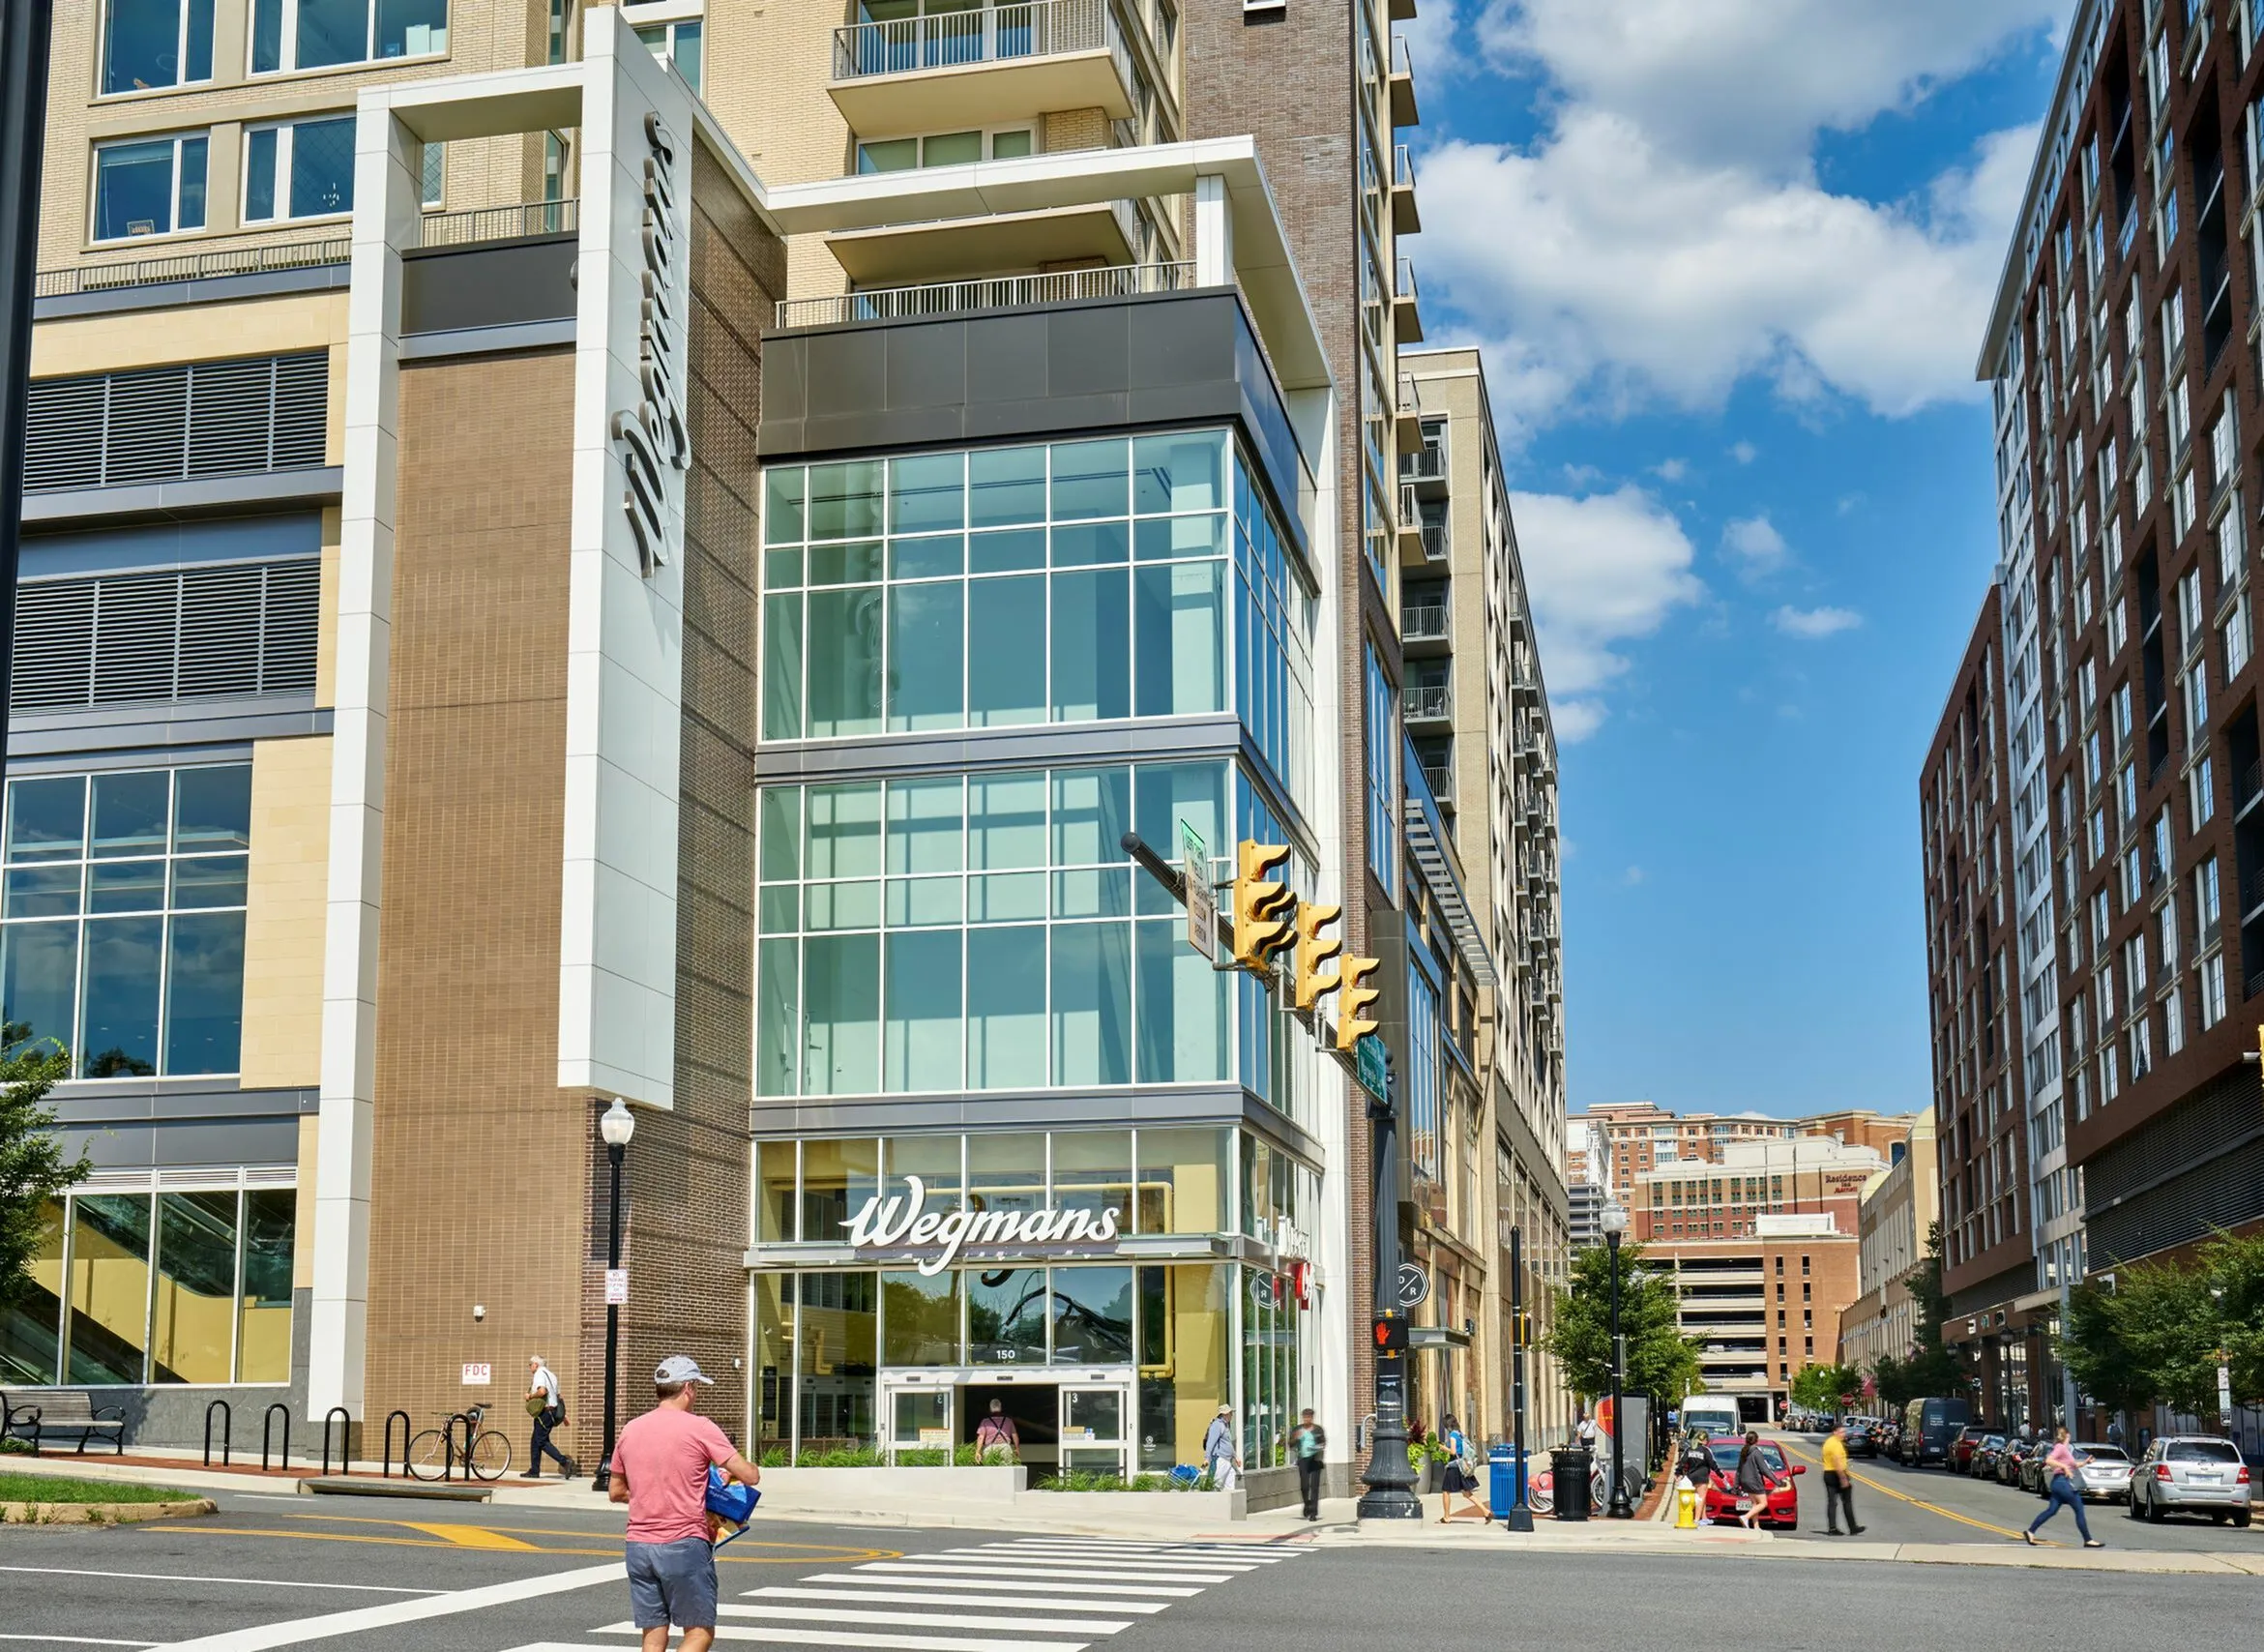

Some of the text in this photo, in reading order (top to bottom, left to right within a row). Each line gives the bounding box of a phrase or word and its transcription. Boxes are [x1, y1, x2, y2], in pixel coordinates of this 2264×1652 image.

[611, 111, 691, 579] Wegmans
[1825, 1174, 1867, 1183] Residence
[838, 1175, 1120, 1276] Wegmans
[996, 1349, 1015, 1359] 150
[465, 1365, 487, 1375] FDC
[1072, 1393, 1078, 1403] 3
